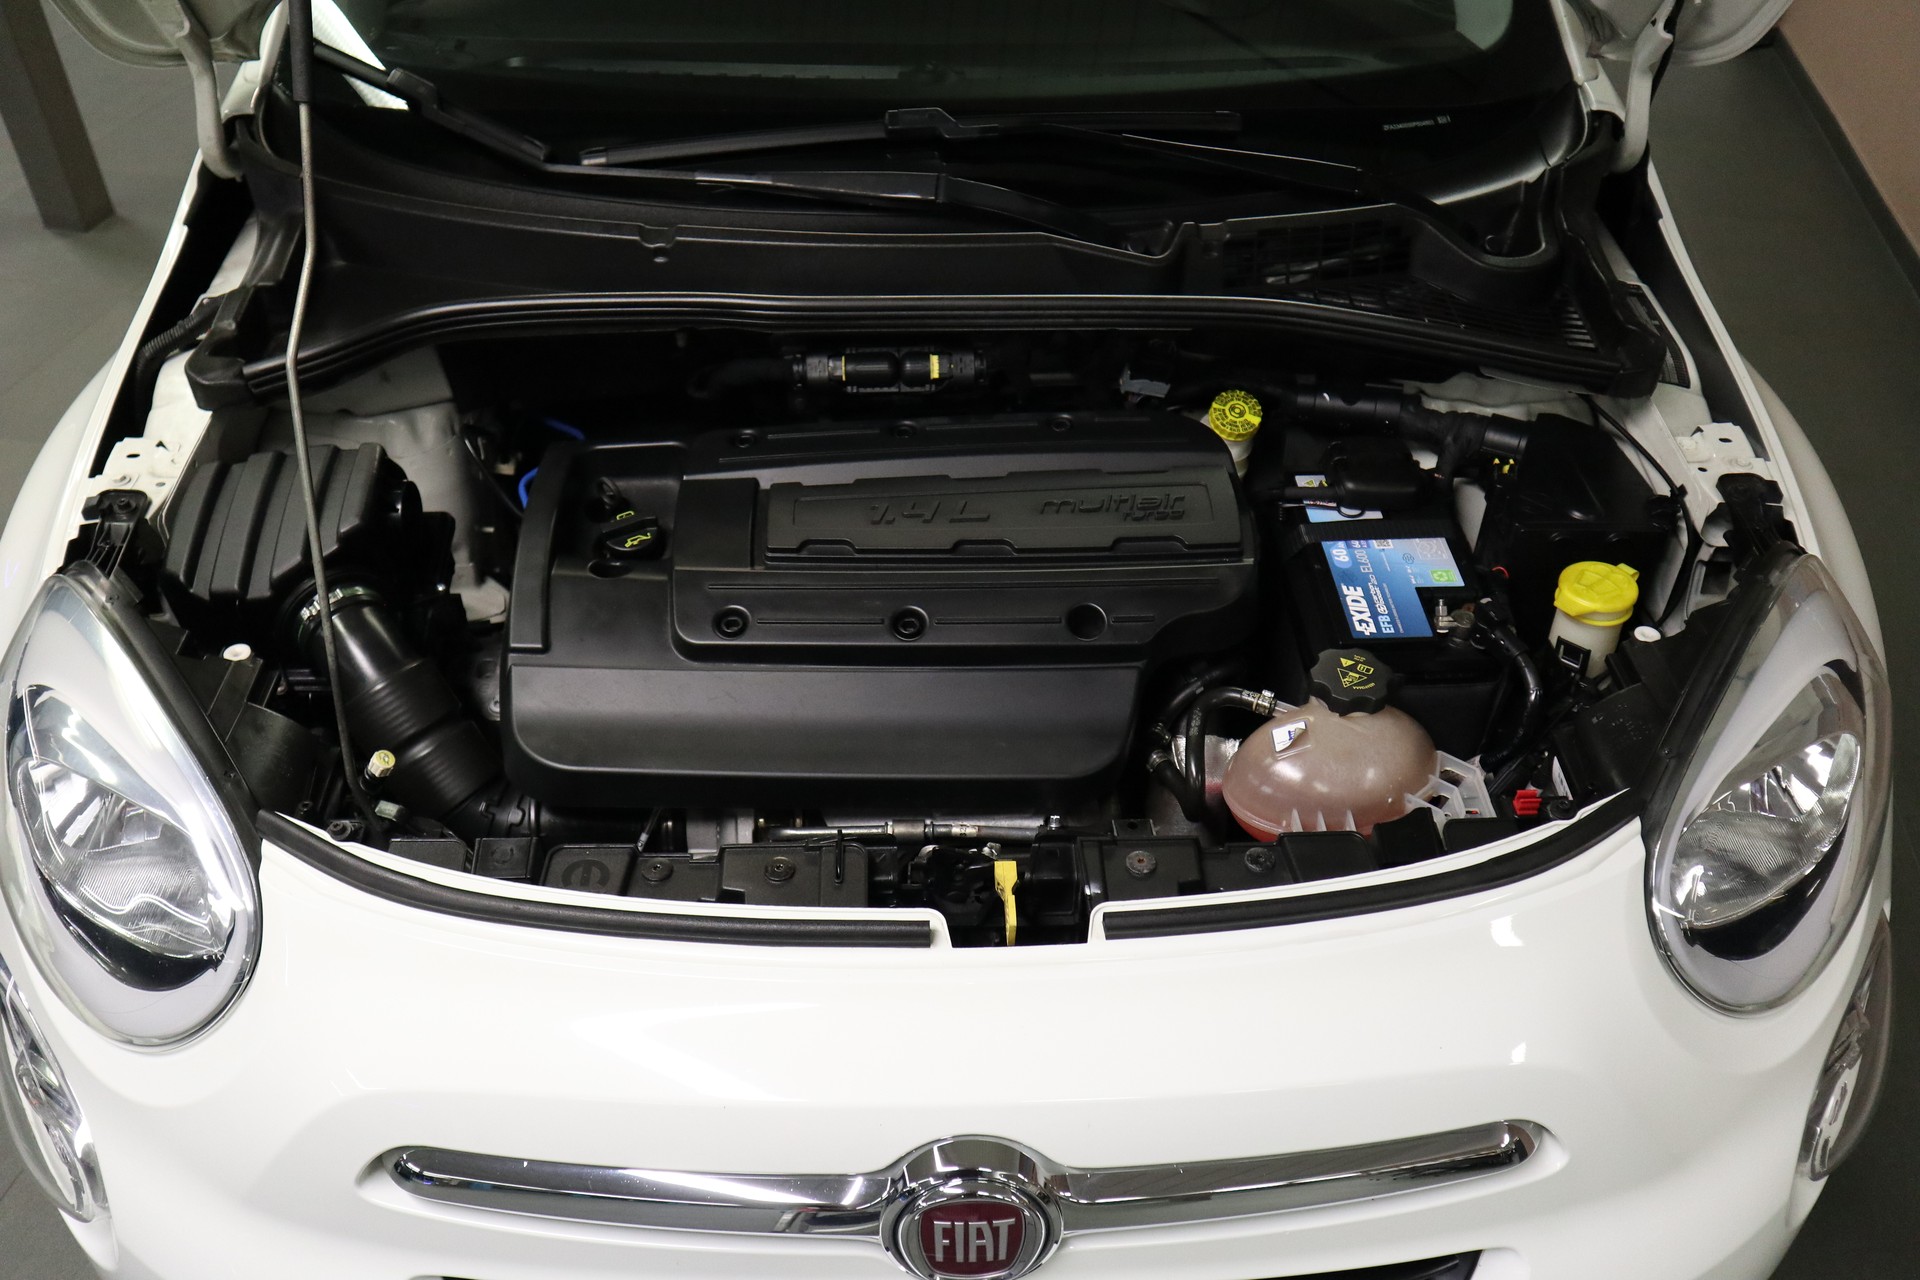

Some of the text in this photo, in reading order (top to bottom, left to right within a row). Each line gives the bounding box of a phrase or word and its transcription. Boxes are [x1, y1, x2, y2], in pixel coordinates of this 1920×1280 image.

[870, 500, 941, 525] 1.4
[1333, 549, 1349, 562] 60
[1354, 549, 1373, 573] EL600
[1341, 583, 1377, 636] EXIDE
[1377, 615, 1395, 634] EFB
[933, 1218, 1016, 1263] FIAT
